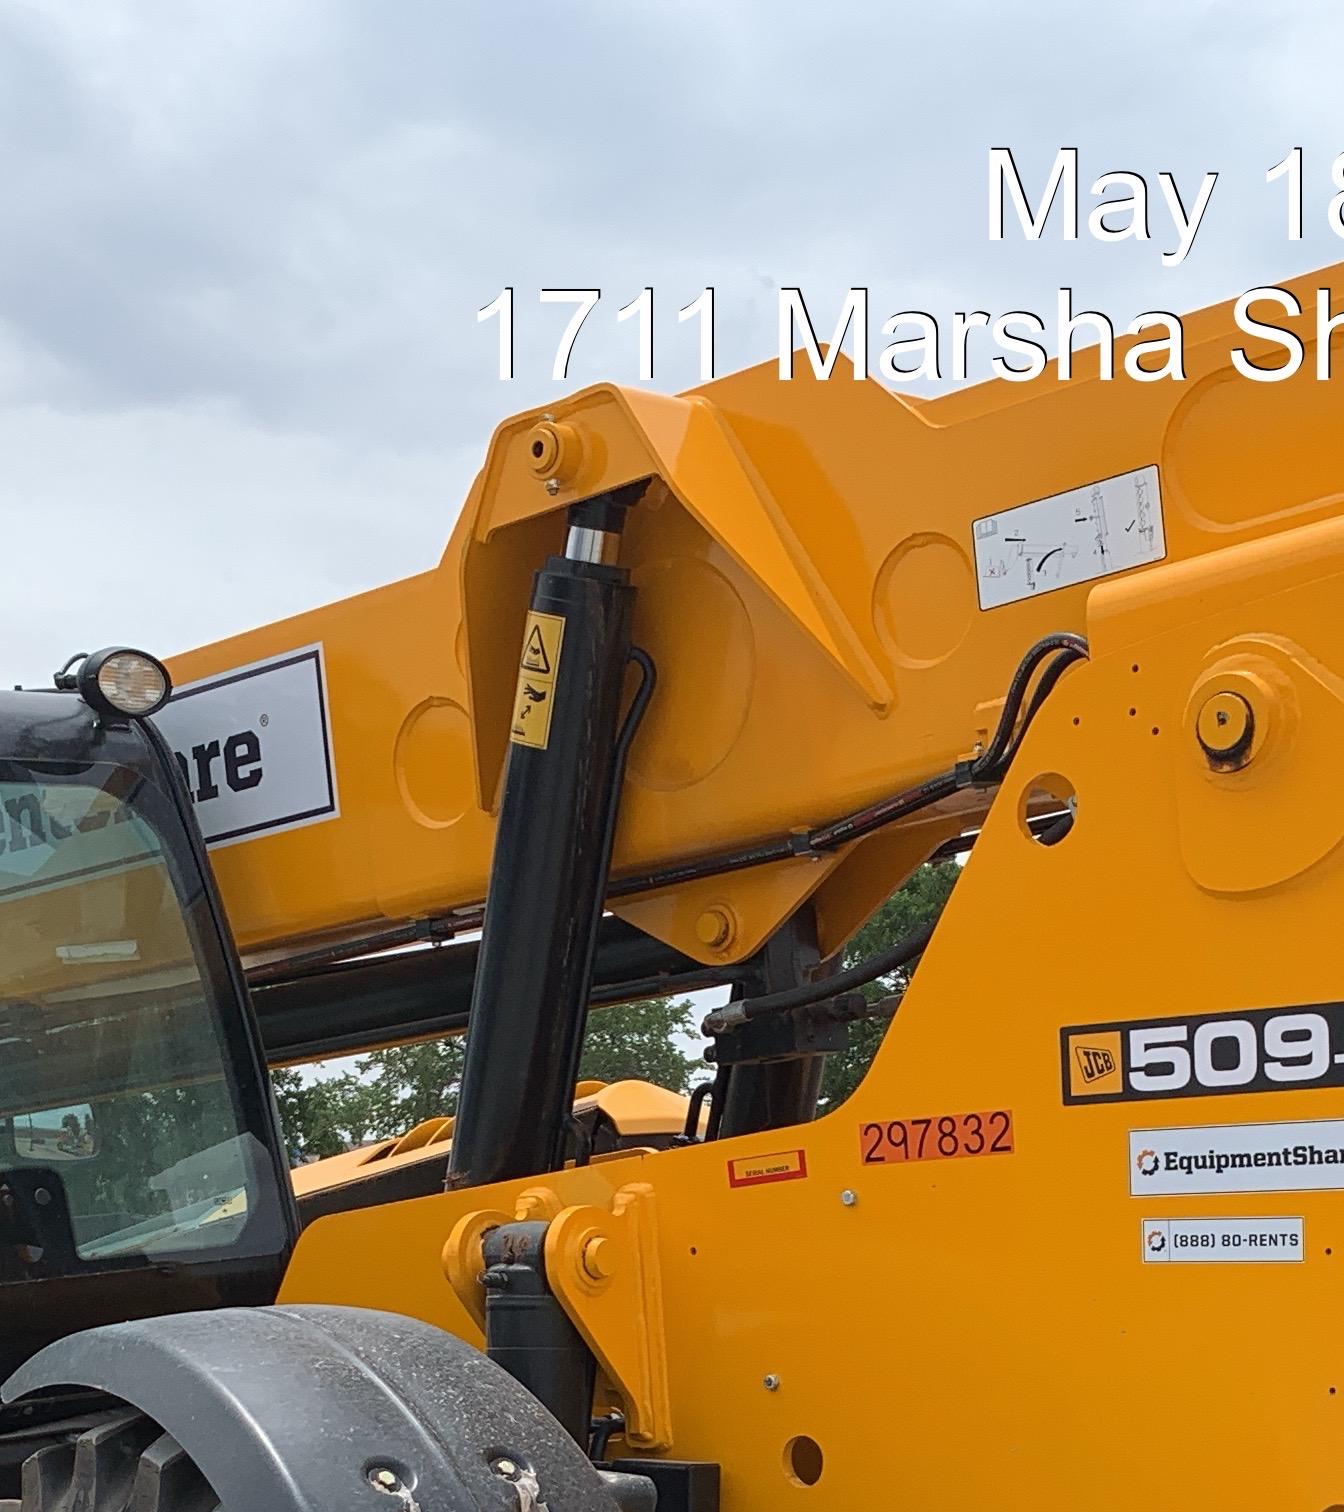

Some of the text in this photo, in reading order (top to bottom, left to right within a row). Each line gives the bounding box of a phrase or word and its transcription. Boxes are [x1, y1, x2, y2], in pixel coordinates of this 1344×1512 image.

[1082, 1050, 1113, 1079] JCB
[863, 1111, 1012, 1163] 297832
[1174, 1233, 1299, 1249] (888) 80-RENTS
